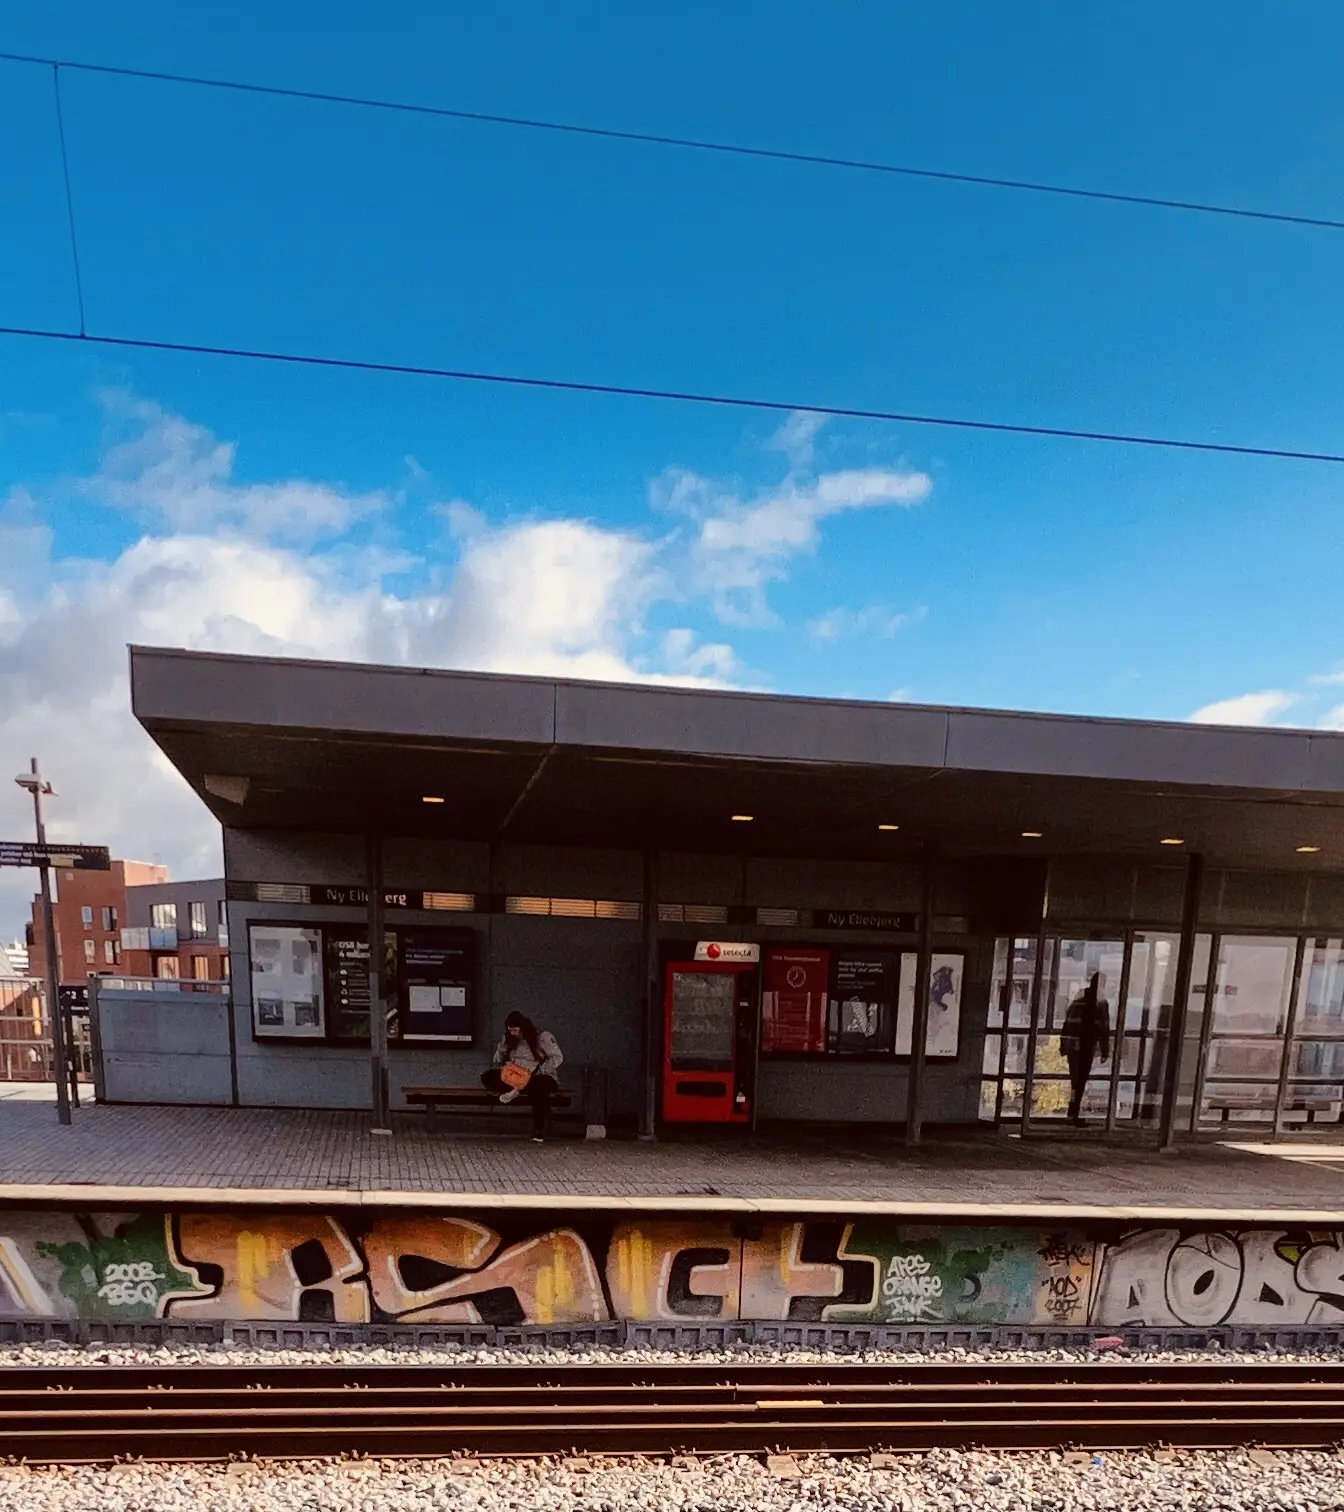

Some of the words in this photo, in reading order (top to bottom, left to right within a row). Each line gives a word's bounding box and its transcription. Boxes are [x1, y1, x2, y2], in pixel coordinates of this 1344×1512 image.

[326, 888, 345, 903] Ny
[828, 913, 846, 927] Ny
[882, 1275, 943, 1298] ORANGE
